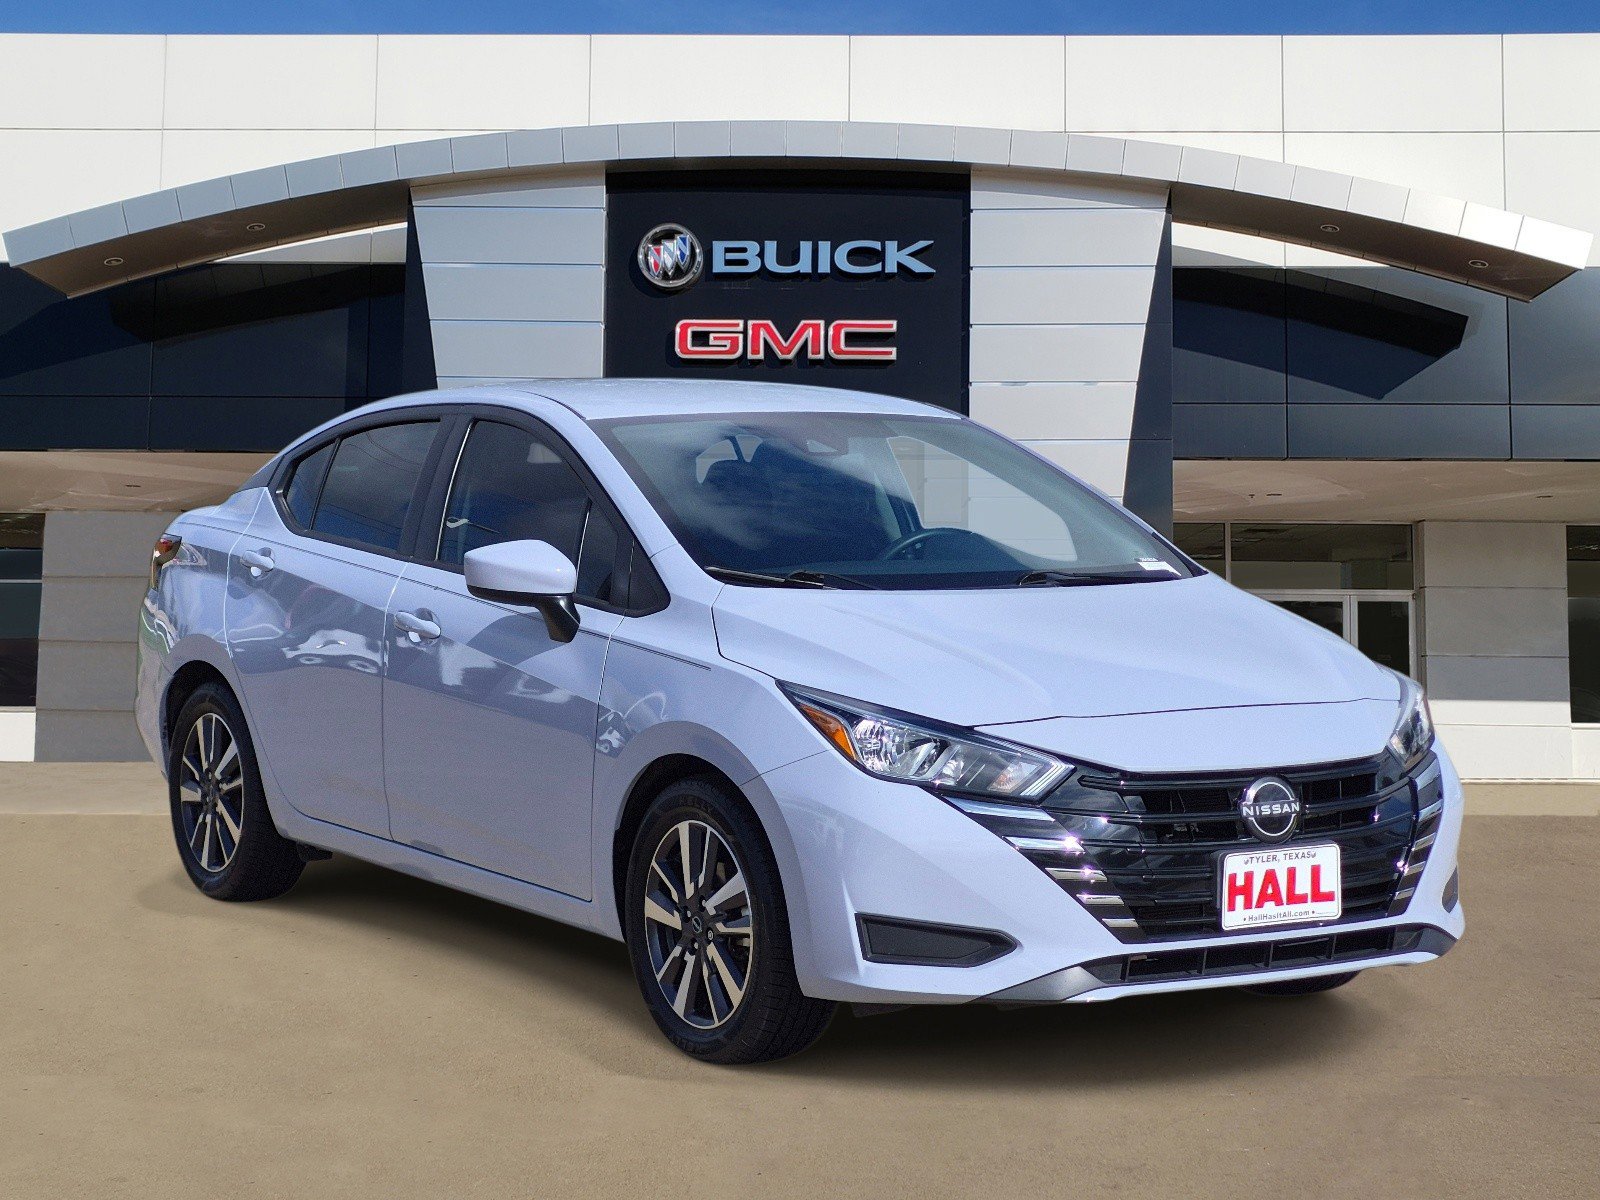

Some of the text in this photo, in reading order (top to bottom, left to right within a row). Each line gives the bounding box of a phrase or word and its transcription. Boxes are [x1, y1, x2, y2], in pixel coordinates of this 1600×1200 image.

[711, 240, 937, 274] BUICK
[674, 318, 898, 361] GMC
[1242, 802, 1300, 817] NISSAN
[1249, 851, 1312, 865] TYLER, TEXAS
[1227, 864, 1336, 912] HALL
